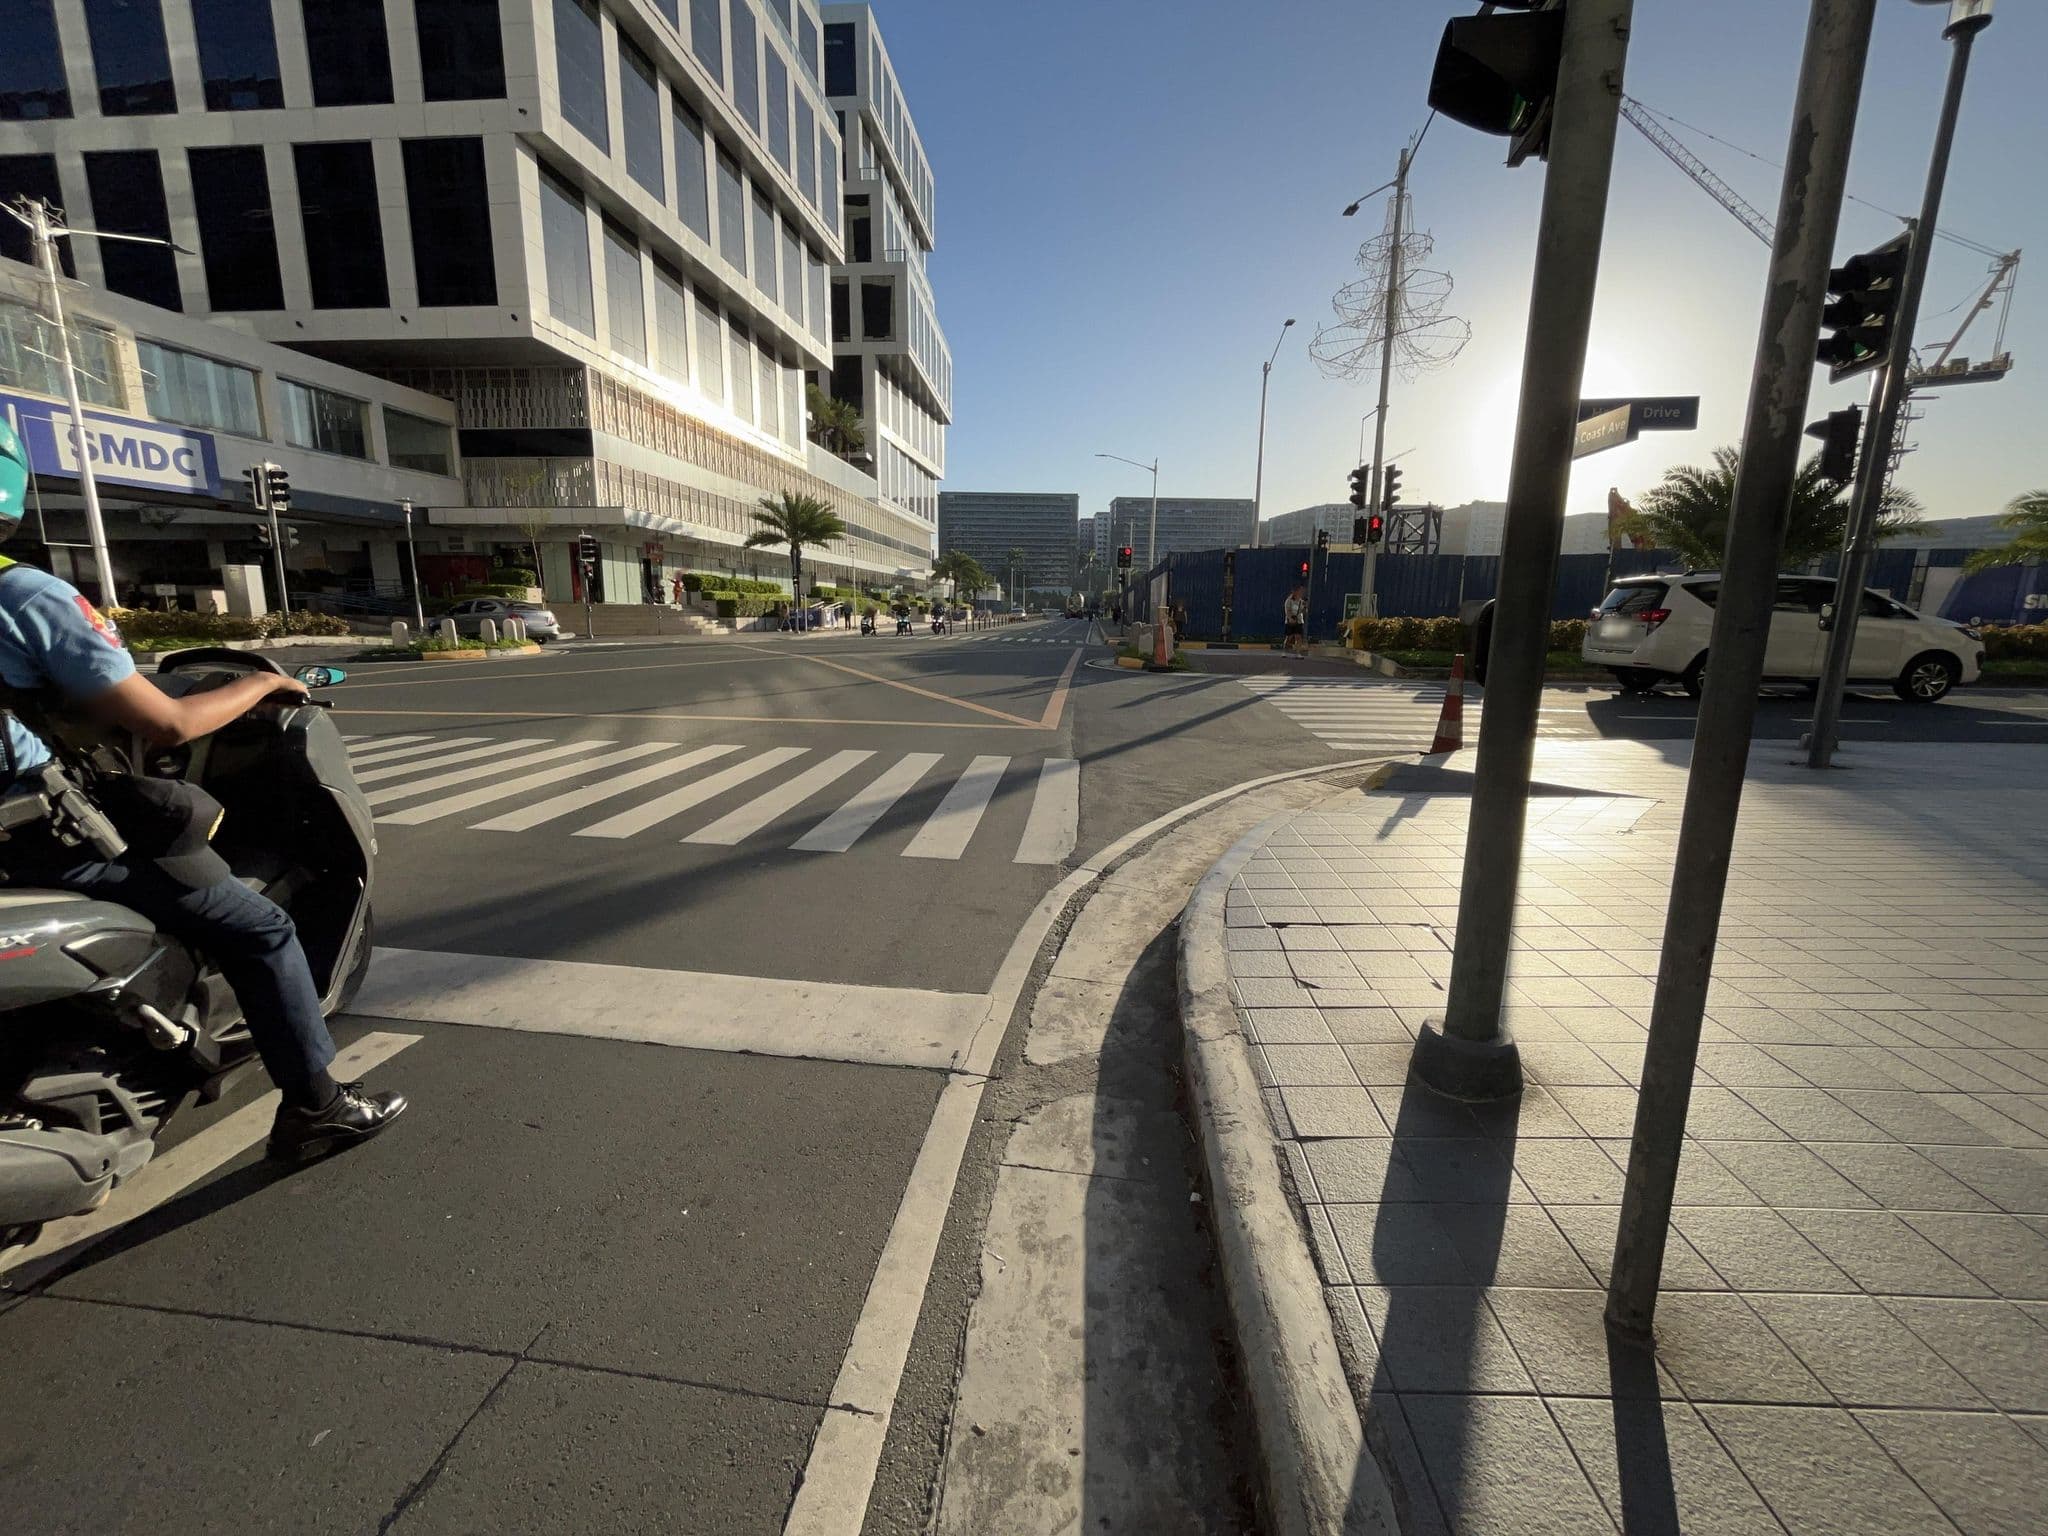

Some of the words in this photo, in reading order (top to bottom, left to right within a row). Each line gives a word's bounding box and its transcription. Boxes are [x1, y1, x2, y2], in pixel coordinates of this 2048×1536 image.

[1643, 406, 1680, 418] Drive
[1580, 426, 1605, 443] Coast
[1608, 421, 1626, 433] Ave
[67, 430, 197, 477] SMDC
